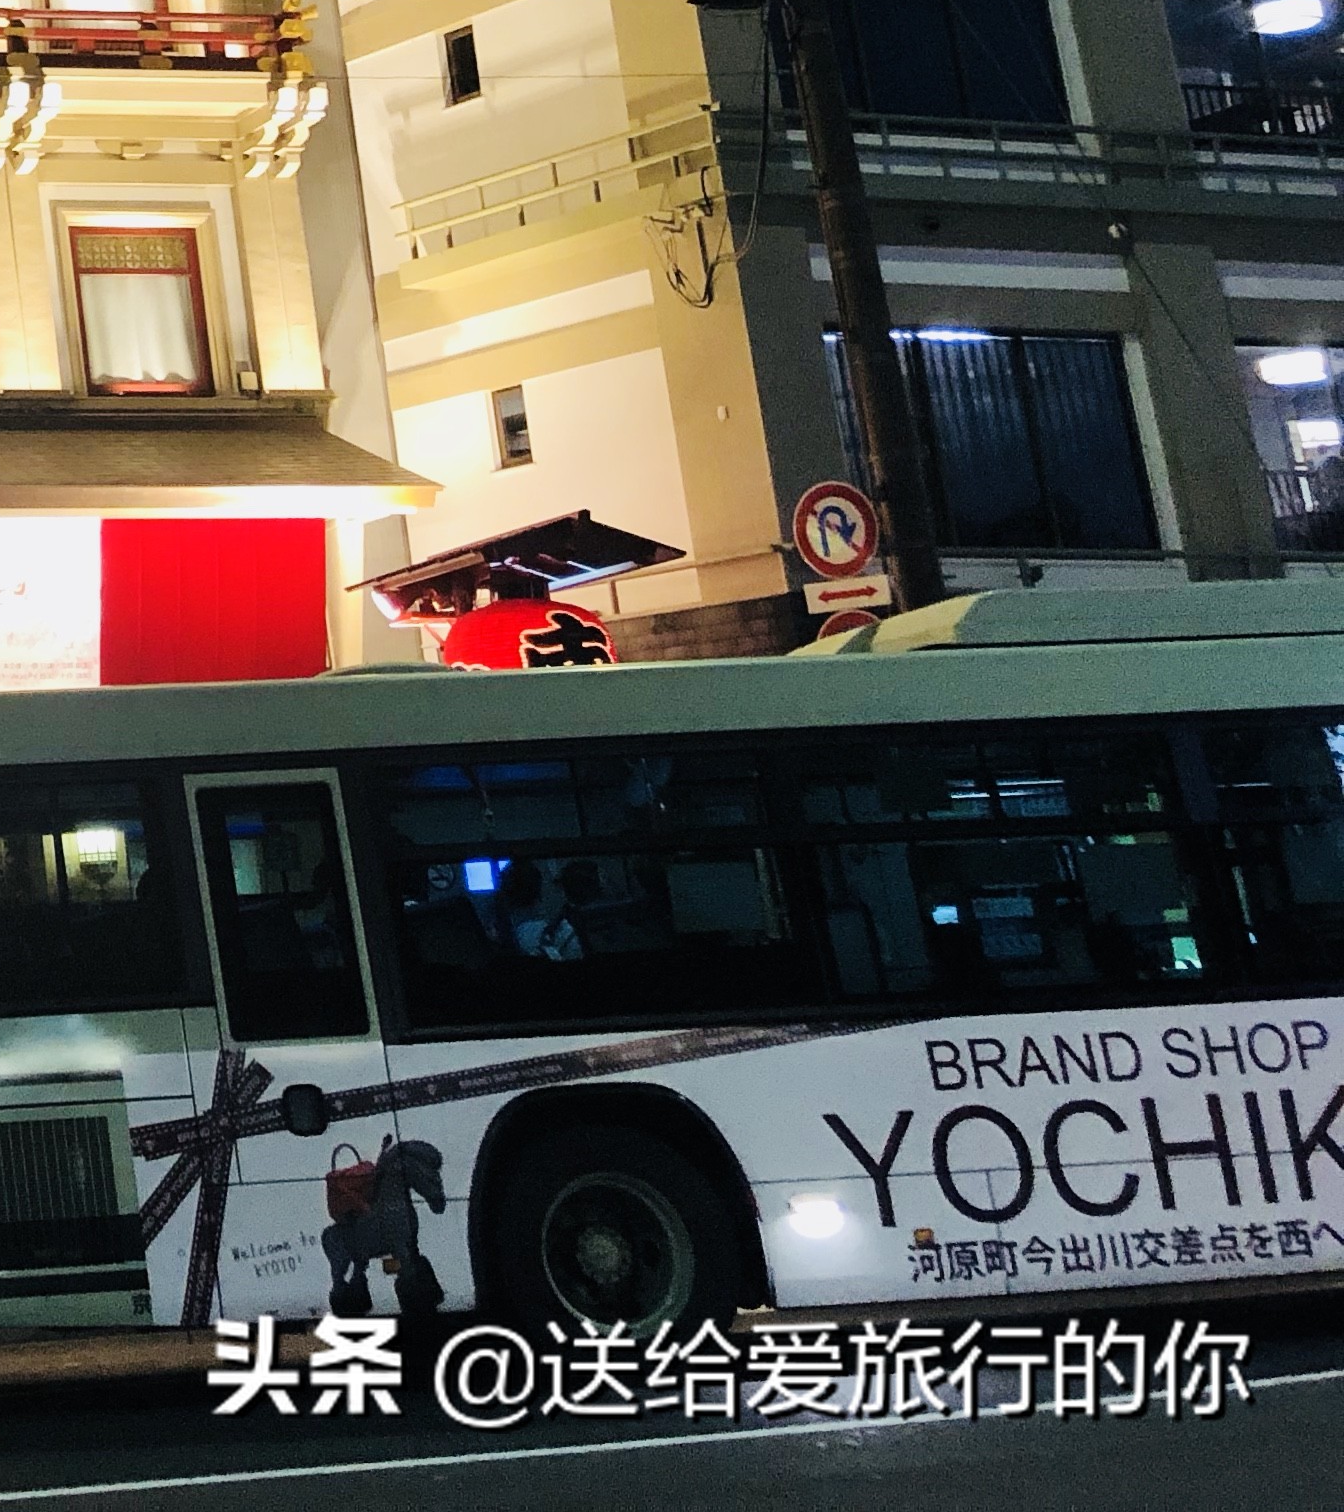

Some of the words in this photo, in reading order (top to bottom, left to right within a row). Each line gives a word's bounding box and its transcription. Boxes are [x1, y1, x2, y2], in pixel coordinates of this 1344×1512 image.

[924, 1029, 1143, 1091] BRAND
[1160, 1019, 1330, 1079] SHOP
[821, 1084, 1344, 1229] YOCHIK
[231, 1240, 291, 1262] Welcome
[298, 1230, 316, 1247] to
[907, 1219, 1344, 1284] 河原町今出川交差点を西へ
